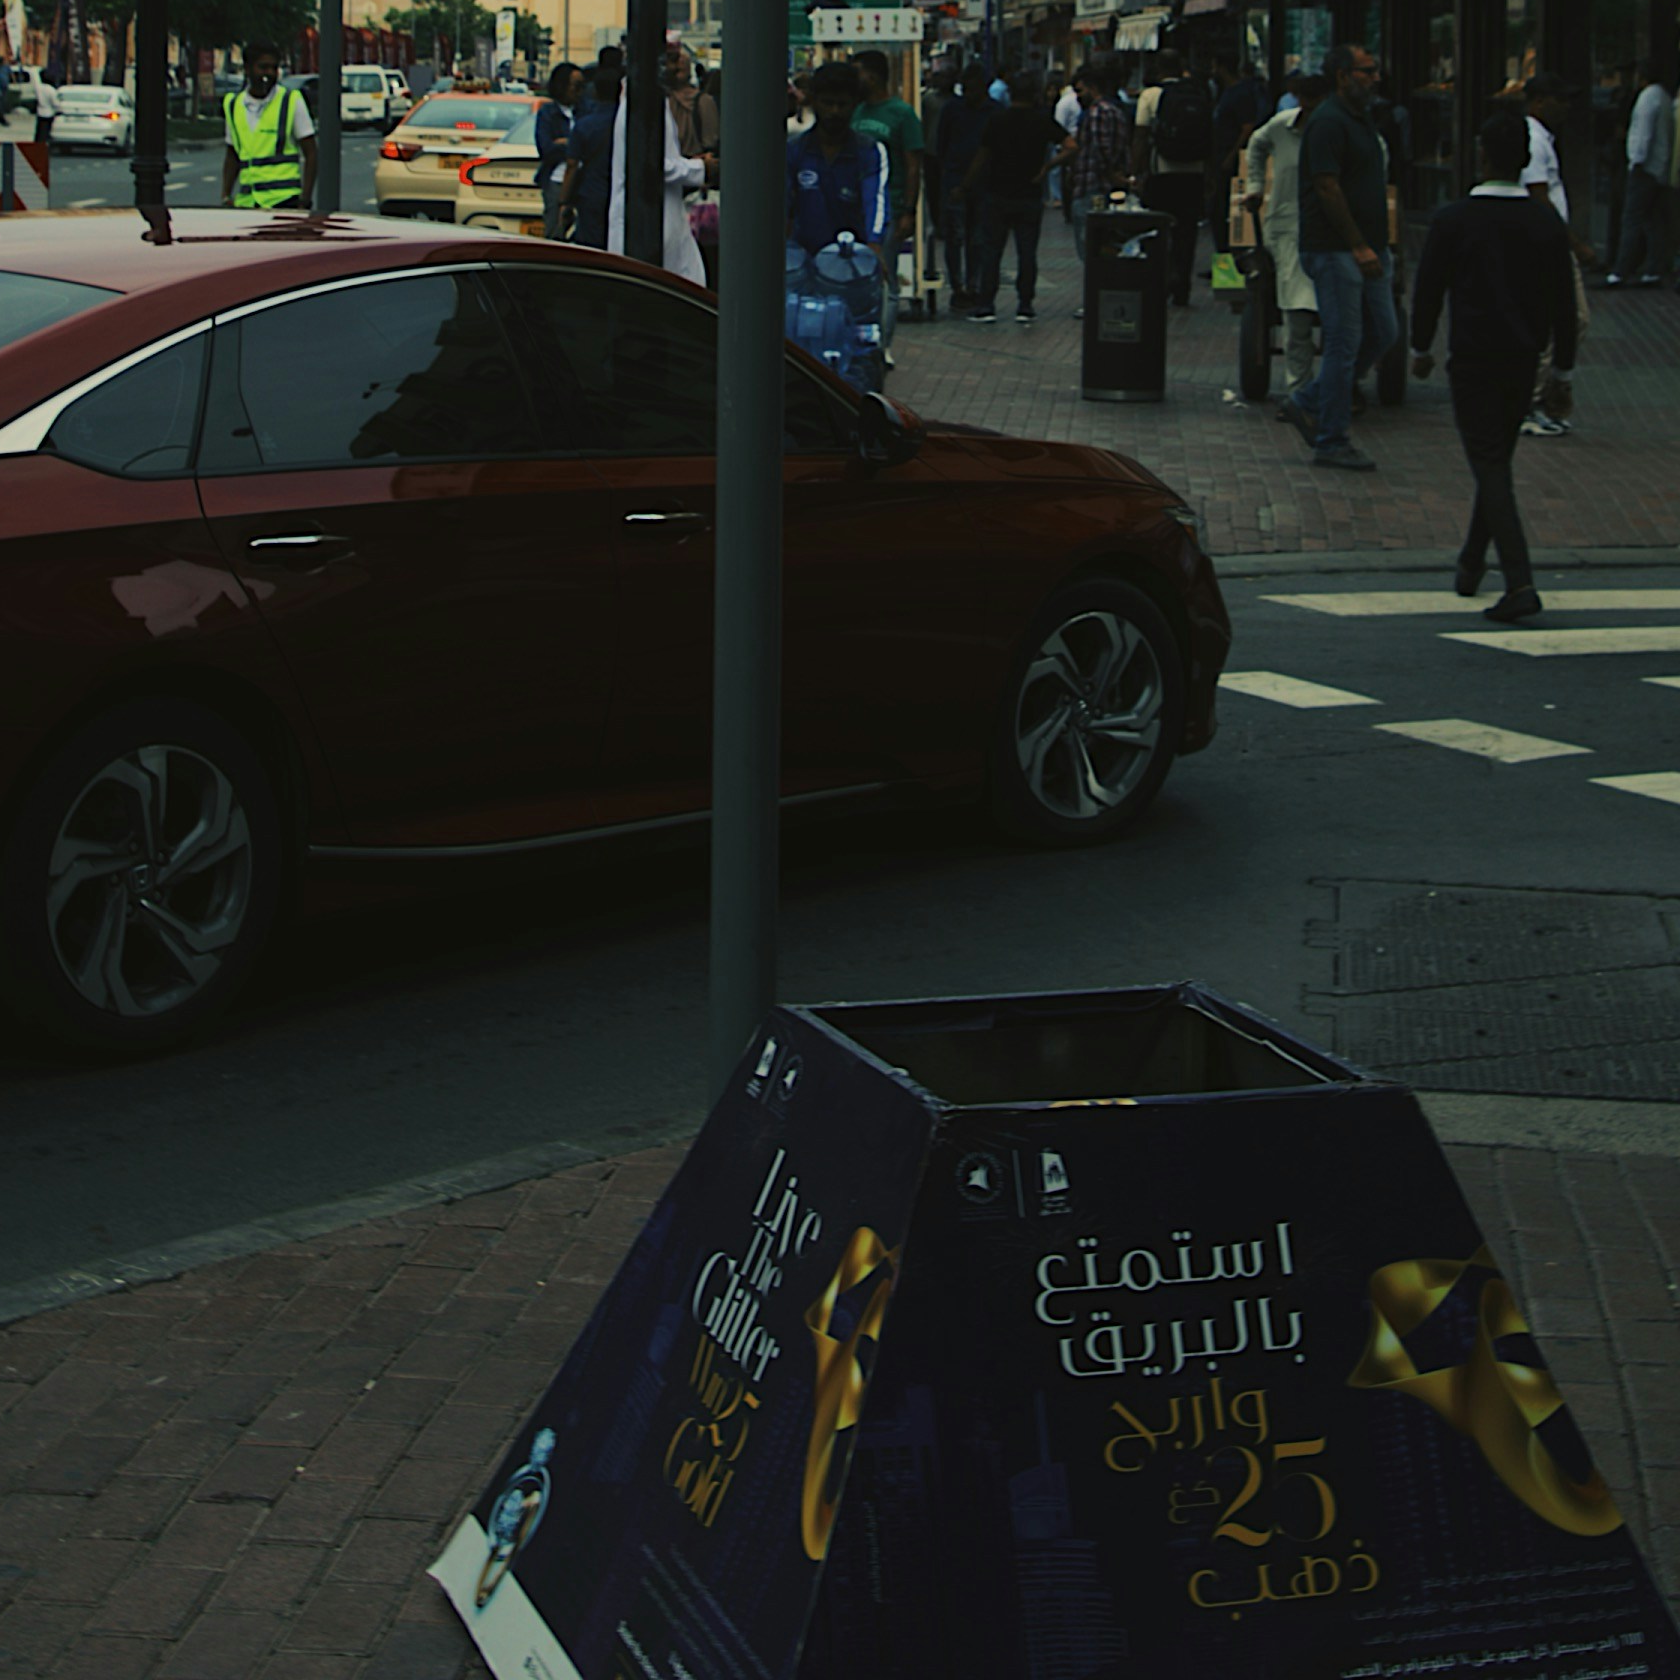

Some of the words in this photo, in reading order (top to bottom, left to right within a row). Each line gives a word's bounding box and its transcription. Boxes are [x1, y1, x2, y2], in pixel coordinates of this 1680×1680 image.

[752, 1148, 821, 1258] Live
[741, 1220, 783, 1297] The
[1033, 1220, 1295, 1326] استمتع
[692, 1251, 781, 1382] Glitter
[1058, 1295, 1307, 1379] بالبريق
[663, 1417, 735, 1528] Gold
[1103, 1376, 1270, 1473] واربح
[1212, 1435, 1337, 1548] 25
[1188, 1538, 1381, 1621] ذهب
